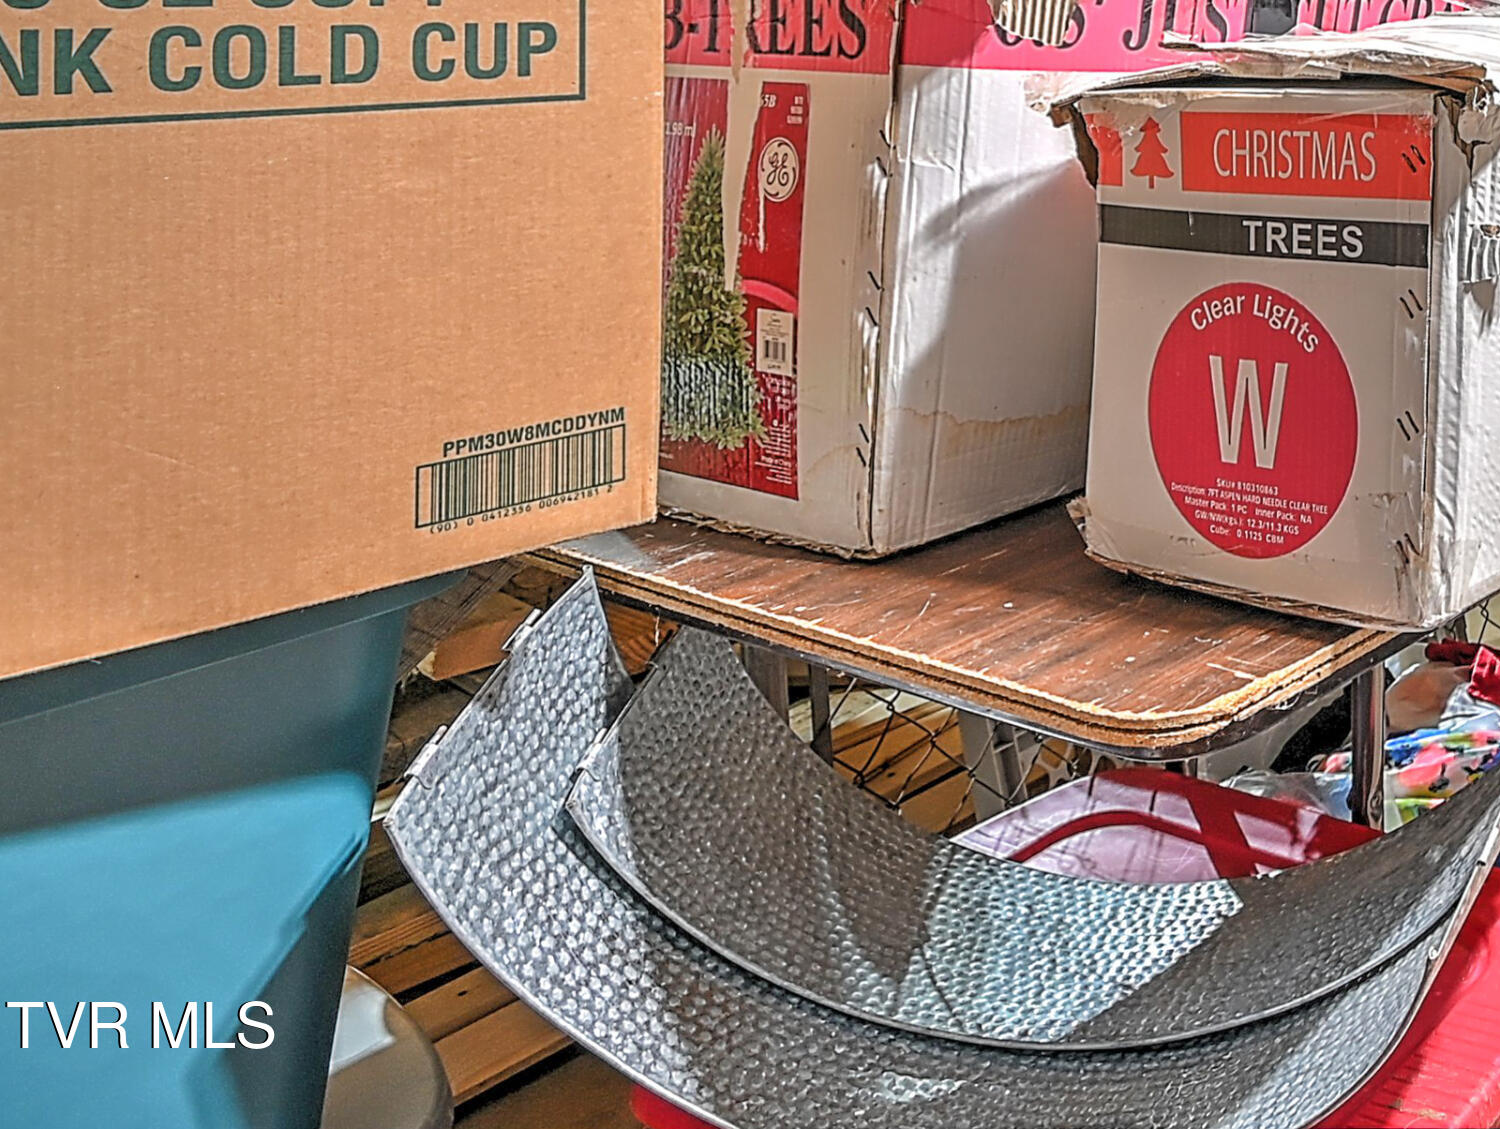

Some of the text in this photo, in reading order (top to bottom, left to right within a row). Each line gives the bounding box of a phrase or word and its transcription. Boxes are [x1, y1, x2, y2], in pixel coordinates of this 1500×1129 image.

[148, 24, 379, 92] COLD
[411, 21, 558, 82] CUP
[1212, 128, 1377, 182] CHRISTMAS
[1242, 219, 1364, 259] TREES
[1190, 294, 1319, 354] Clear Lights
[443, 407, 625, 457] PPM30W8MCDDYNM
[1209, 354, 1289, 470] W
[1237, 505, 1248, 515] PC
[1262, 498, 1287, 509] NEEDLE
[1289, 501, 1311, 512] CLEAR
[1283, 523, 1300, 535] KGS
